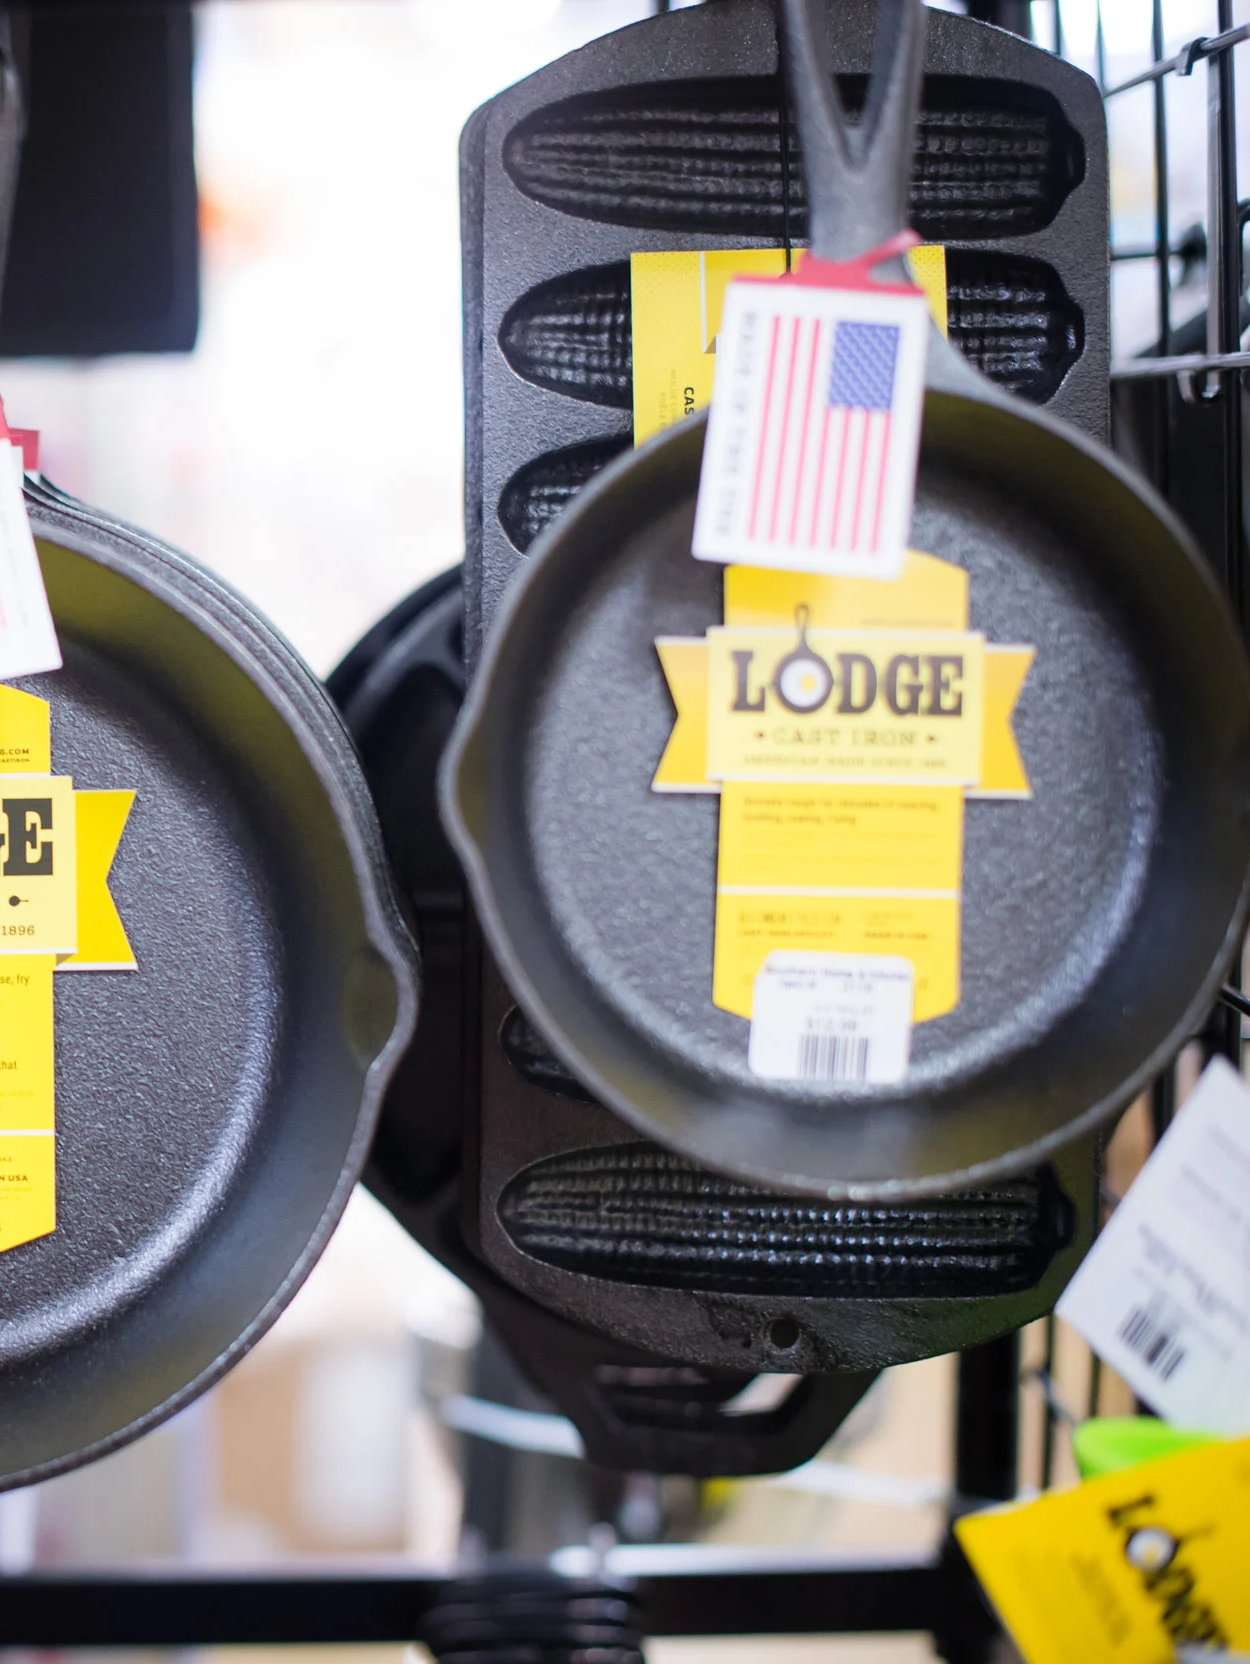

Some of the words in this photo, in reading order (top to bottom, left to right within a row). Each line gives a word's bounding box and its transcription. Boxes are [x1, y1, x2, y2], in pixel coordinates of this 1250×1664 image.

[730, 650, 964, 718] LODGE
[772, 727, 840, 747] CAST
[850, 728, 916, 749] IRON
[2, 925, 36, 937] 1896
[16, 974, 30, 986] fry
[8, 1174, 28, 1182] USA
